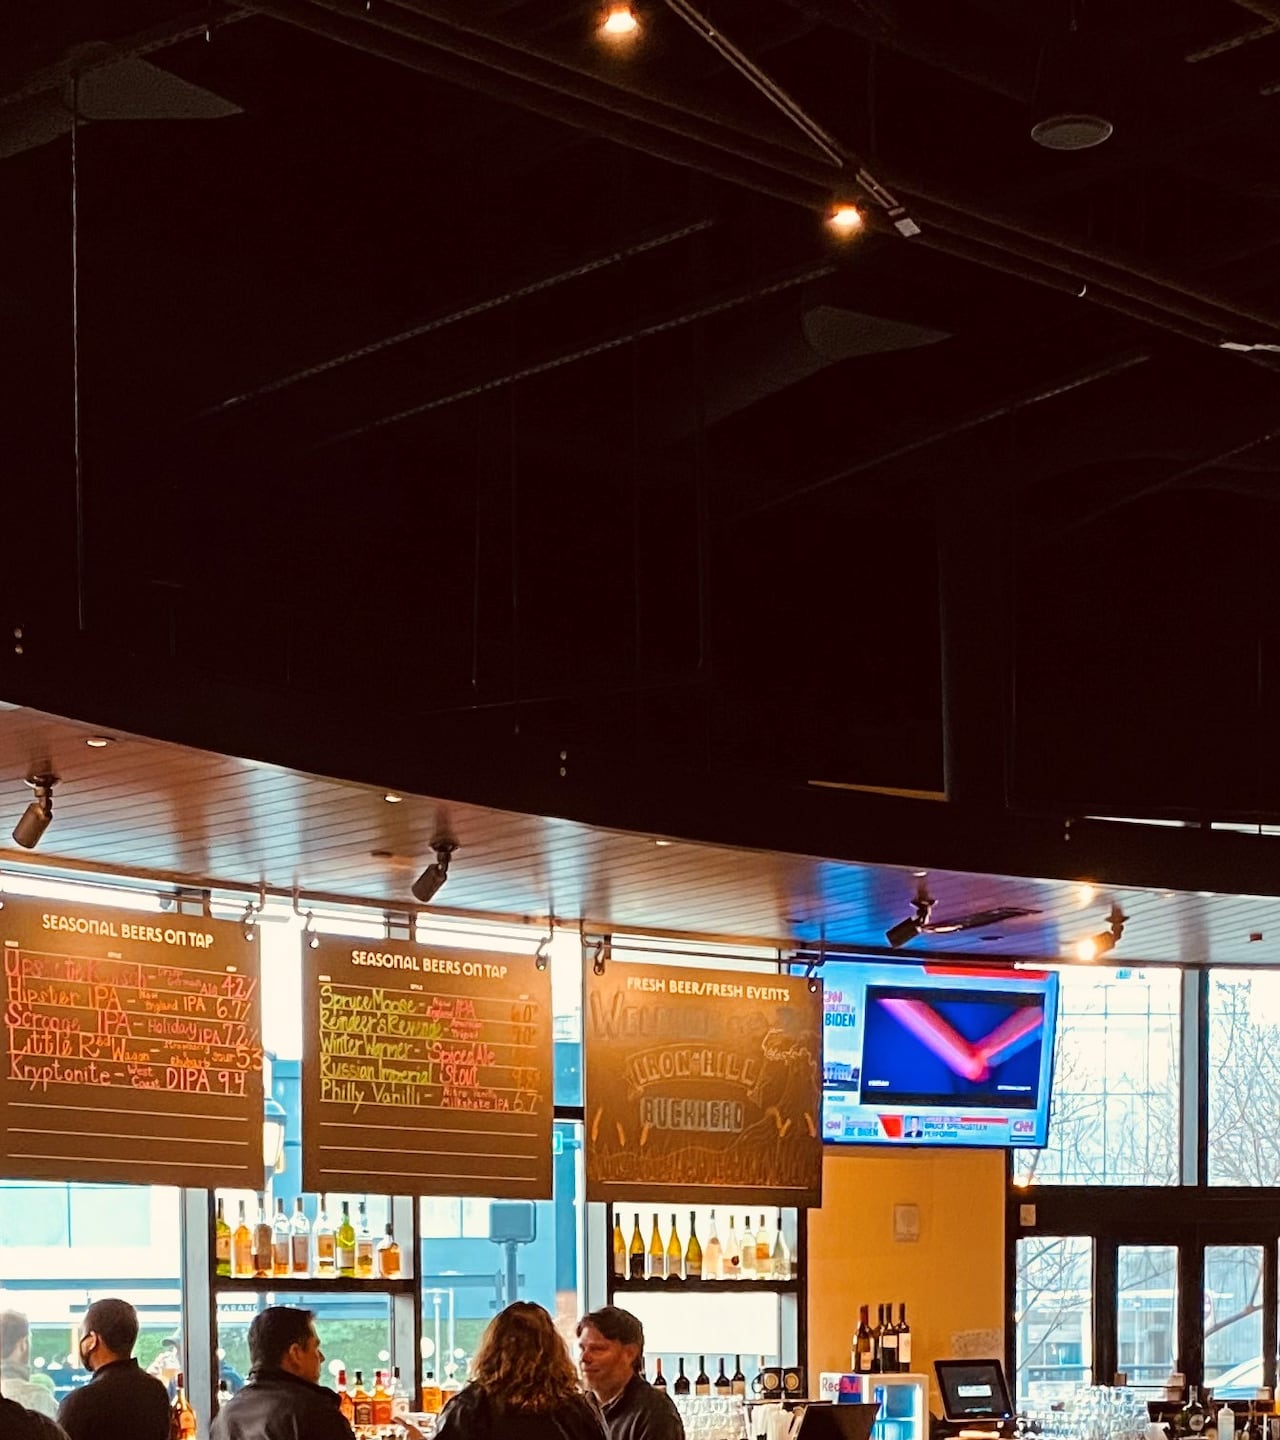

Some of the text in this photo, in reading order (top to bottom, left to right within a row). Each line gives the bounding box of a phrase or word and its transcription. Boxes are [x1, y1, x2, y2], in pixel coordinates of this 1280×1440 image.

[42, 913, 214, 949] SEASONAL BEERS ON TAP
[351, 950, 508, 979] SEASONAL BEERS ON TAP
[7, 976, 80, 1014] Hipster
[87, 986, 122, 1012] IPA
[183, 996, 206, 1012] IPA
[320, 985, 373, 1017] Spruce
[372, 988, 417, 1014] Moose
[627, 977, 790, 1002] FRESH BEER/FRESH EVENTS
[97, 1009, 132, 1038] IPA
[148, 1017, 197, 1040] Holiday
[199, 1028, 221, 1045] IPA
[825, 1012, 856, 1028] BIDEN
[9, 1026, 73, 1056] Little
[80, 1032, 110, 1058] Red
[319, 1031, 363, 1056] Winter
[363, 1032, 413, 1060] Warmer
[10, 1054, 111, 1092] Kryptonite
[166, 1065, 211, 1093] DIPA
[321, 1055, 480, 1088] Russian Imperial Stout
[632, 1049, 757, 1090] IRON HILL
[321, 1079, 365, 1115] Philly
[493, 1098, 509, 1112] IPA
[640, 1097, 744, 1132] BUCKHEAD
[1013, 1121, 1034, 1133] CNN
